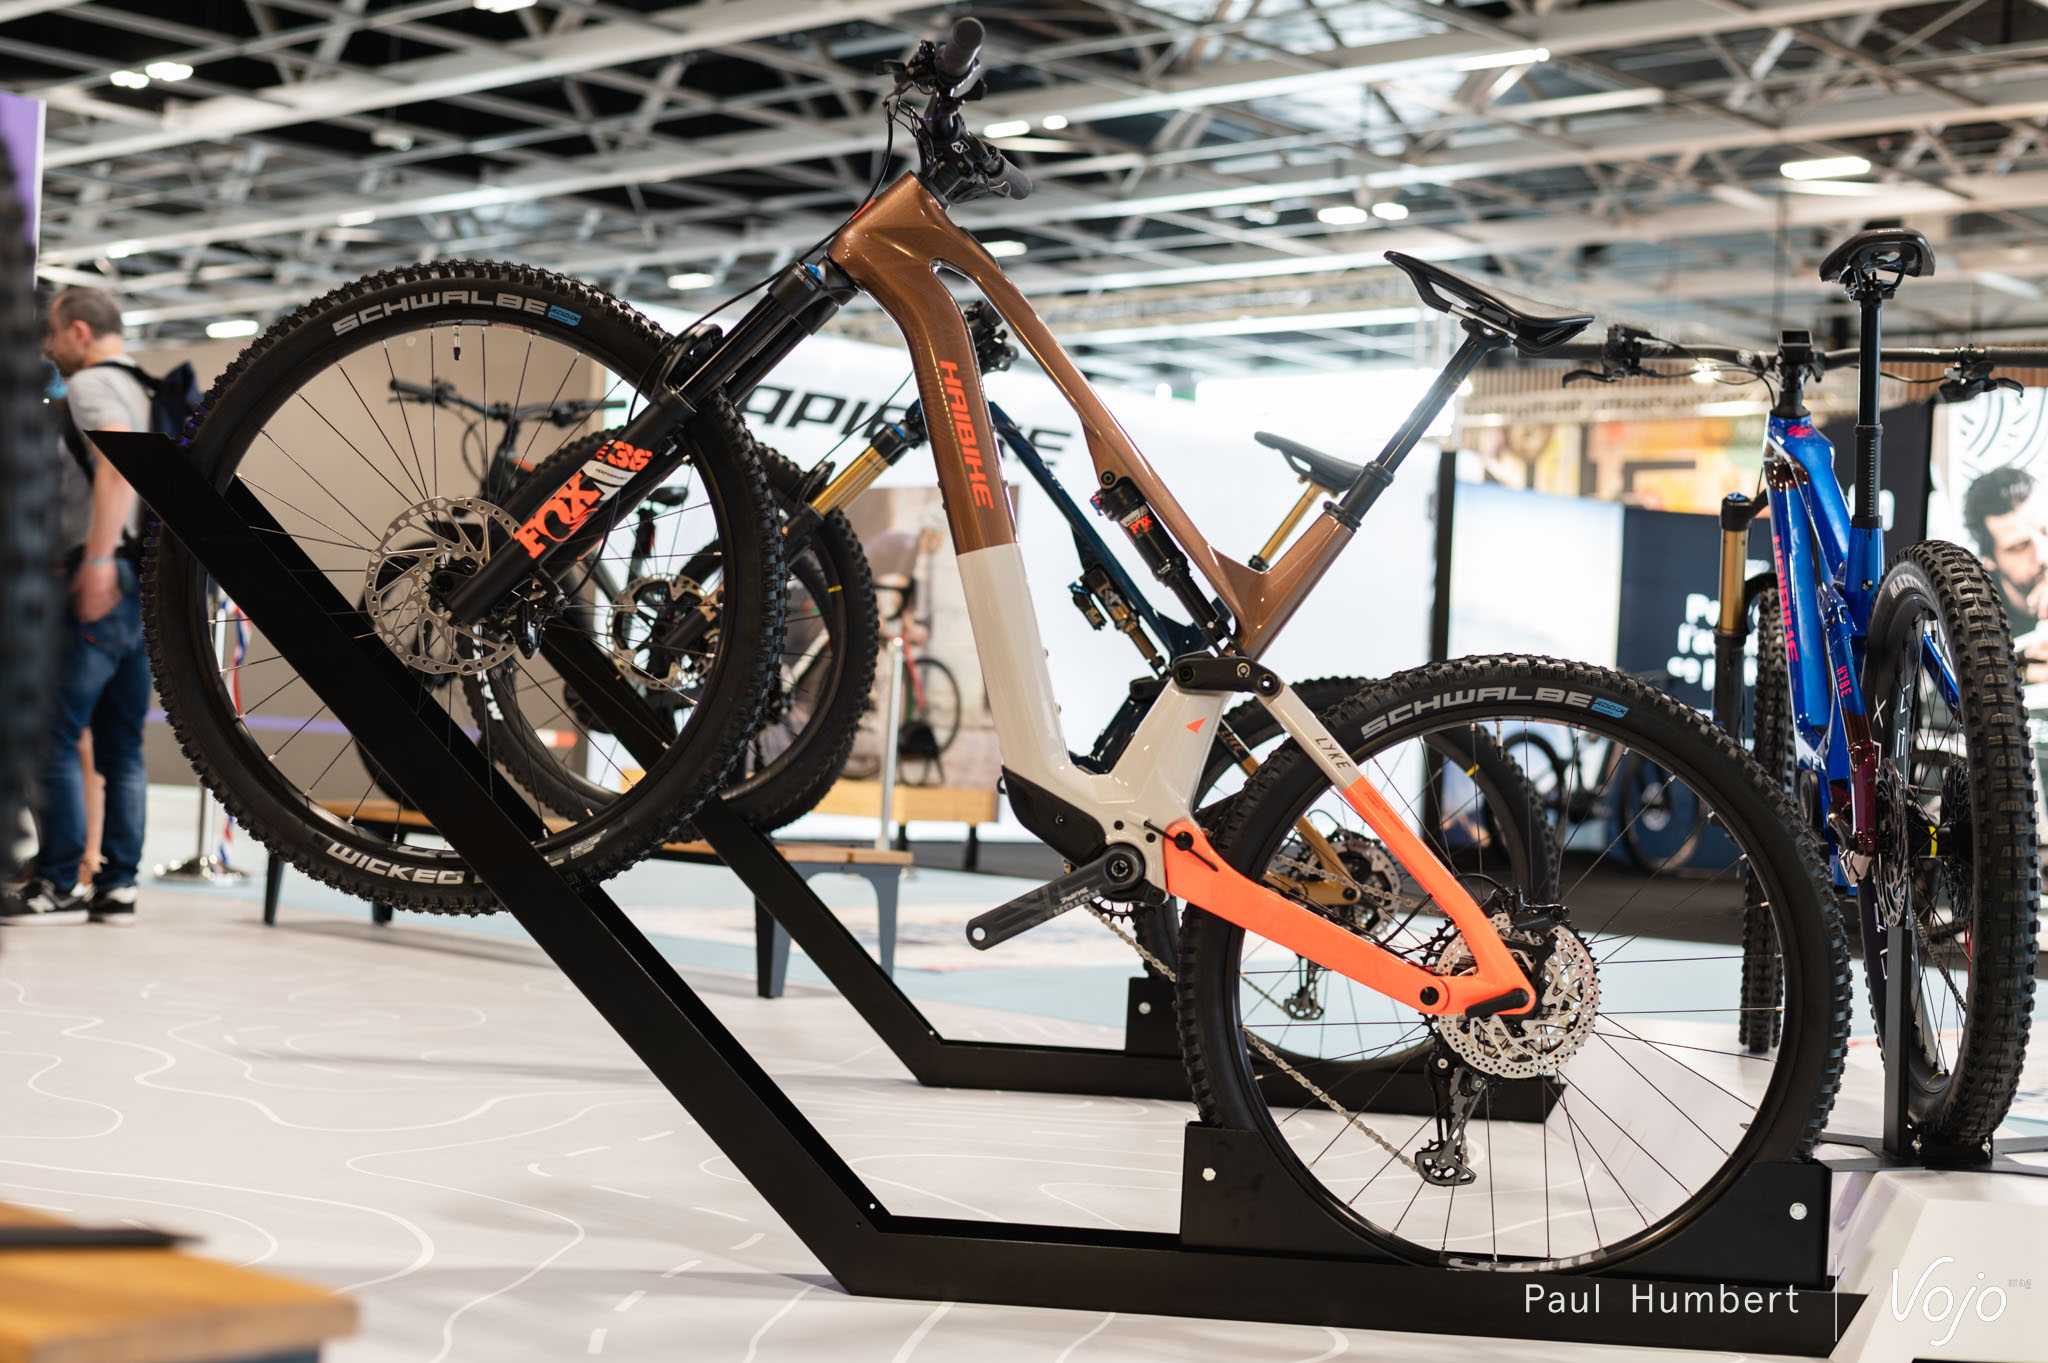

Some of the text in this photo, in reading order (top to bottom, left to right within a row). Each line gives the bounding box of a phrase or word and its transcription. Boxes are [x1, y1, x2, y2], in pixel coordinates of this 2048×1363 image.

[332, 290, 548, 336] SCHWALBE
[939, 360, 994, 509] HAIBIKE
[513, 472, 603, 559] FOX
[1772, 535, 1799, 663] HAIBIKE
[1835, 665, 1852, 699] HYBE
[1360, 687, 1592, 739] SCHWALBE
[1315, 738, 1352, 769] LYKE
[326, 842, 465, 885] WICKED
